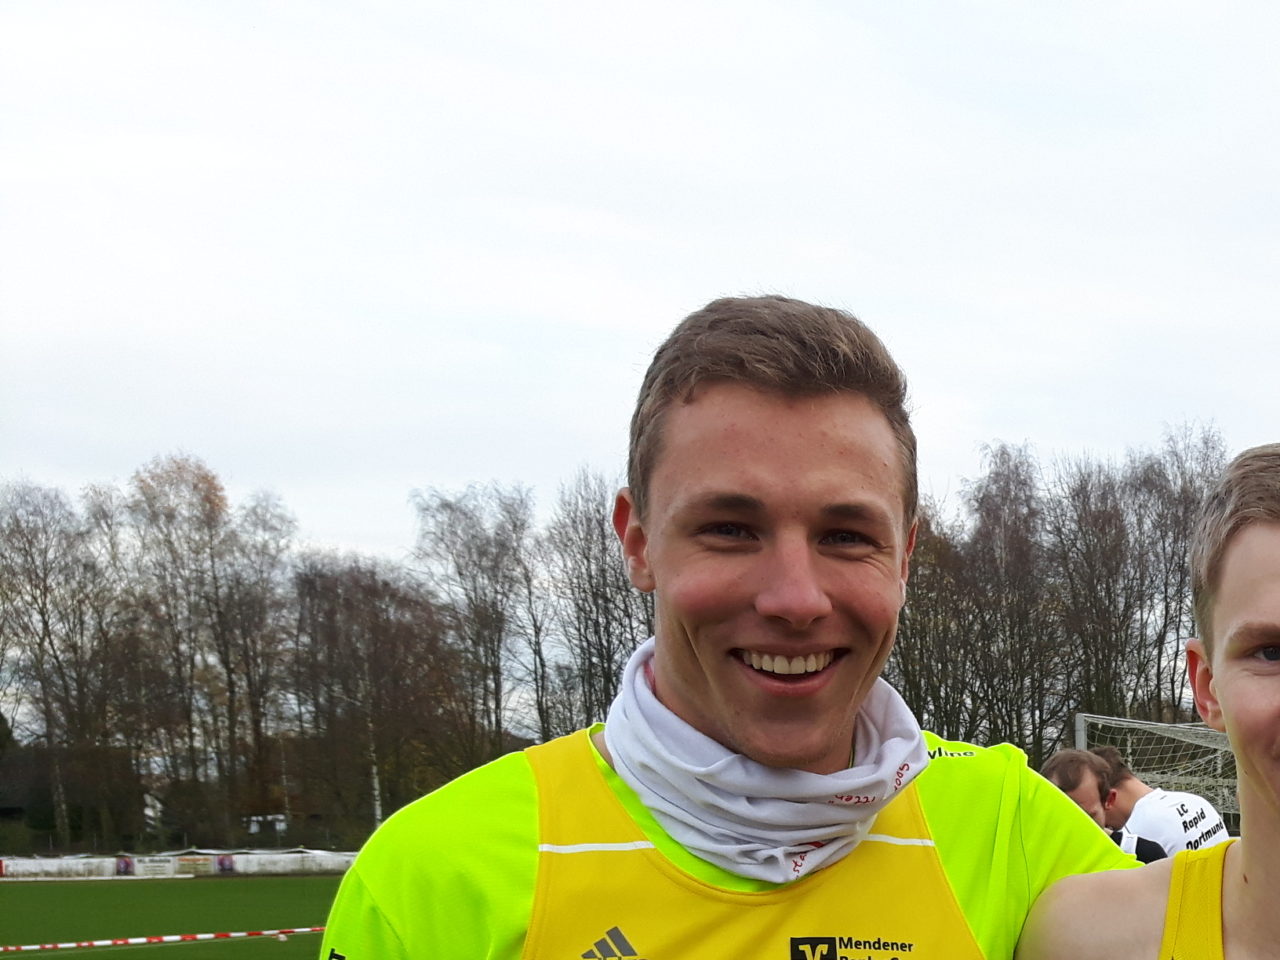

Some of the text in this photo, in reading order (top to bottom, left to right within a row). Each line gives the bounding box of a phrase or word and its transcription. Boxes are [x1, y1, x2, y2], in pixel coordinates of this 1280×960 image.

[1176, 803, 1189, 817] LC
[1182, 808, 1206, 833] Rapid
[838, 936, 914, 953] Mendener
